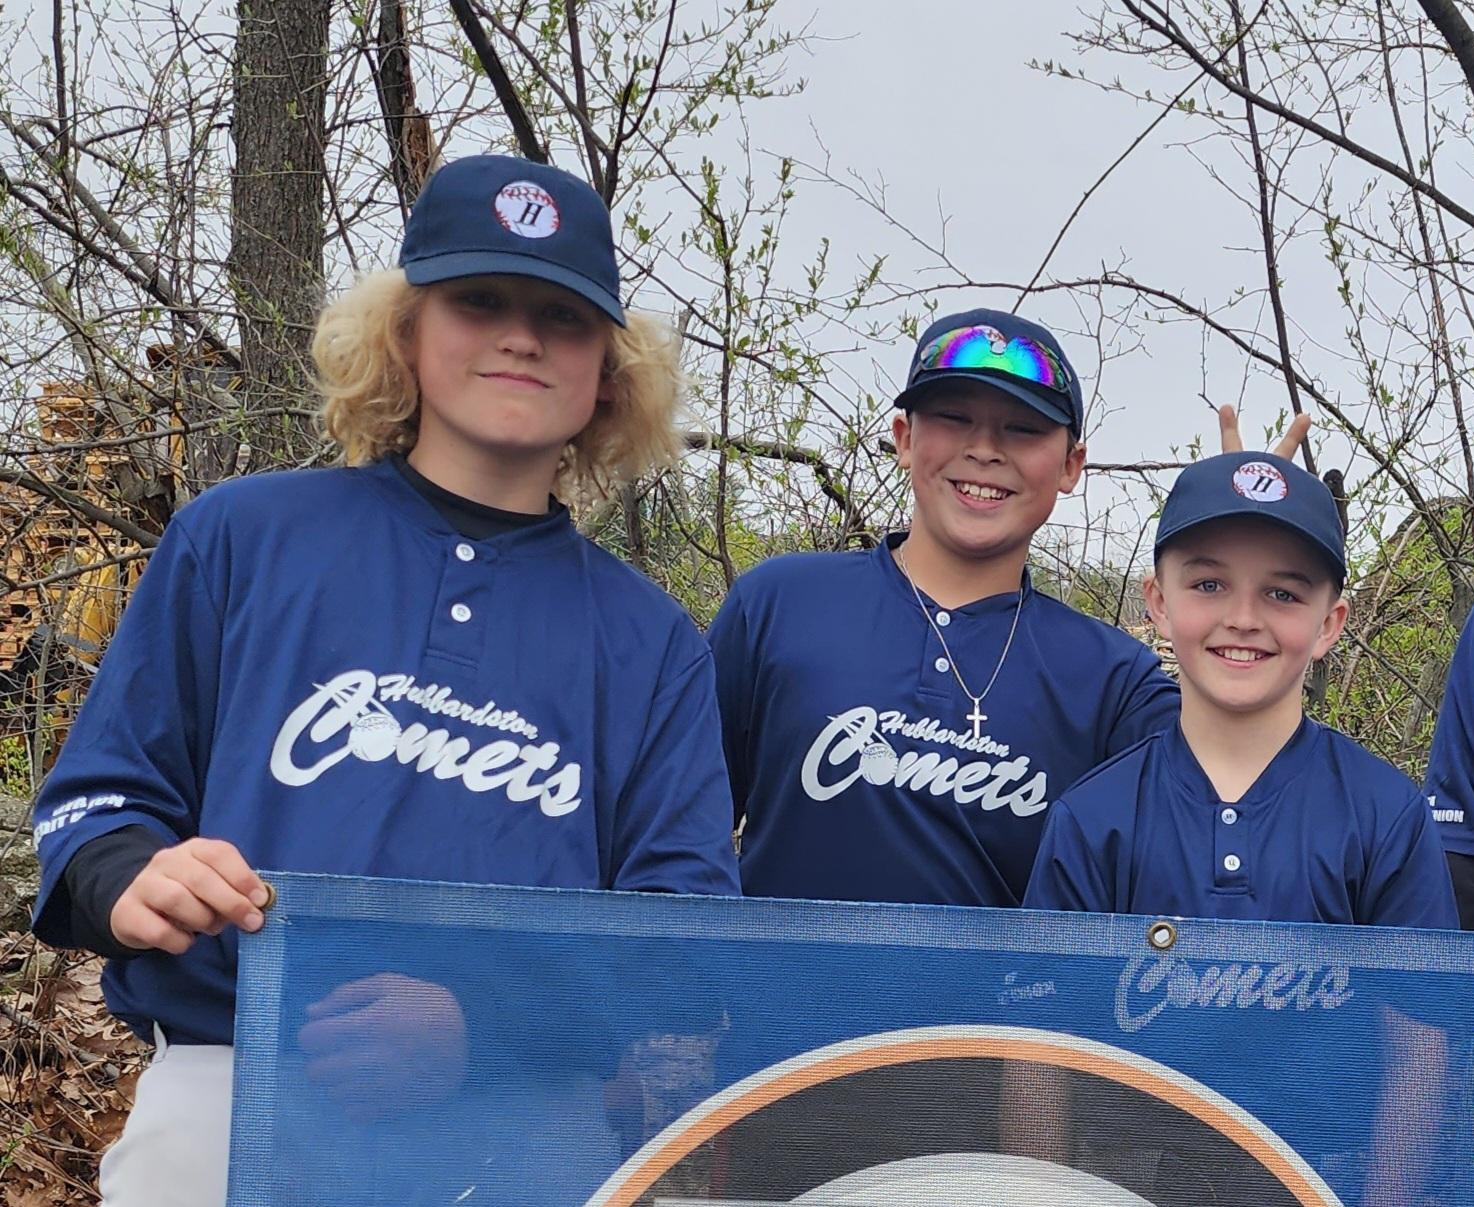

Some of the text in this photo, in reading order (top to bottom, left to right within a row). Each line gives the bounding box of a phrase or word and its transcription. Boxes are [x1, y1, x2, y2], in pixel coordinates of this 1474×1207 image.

[378, 673, 539, 740] Hubbardston
[878, 710, 1010, 758] Hubbardston
[1432, 809, 1465, 823] NION
